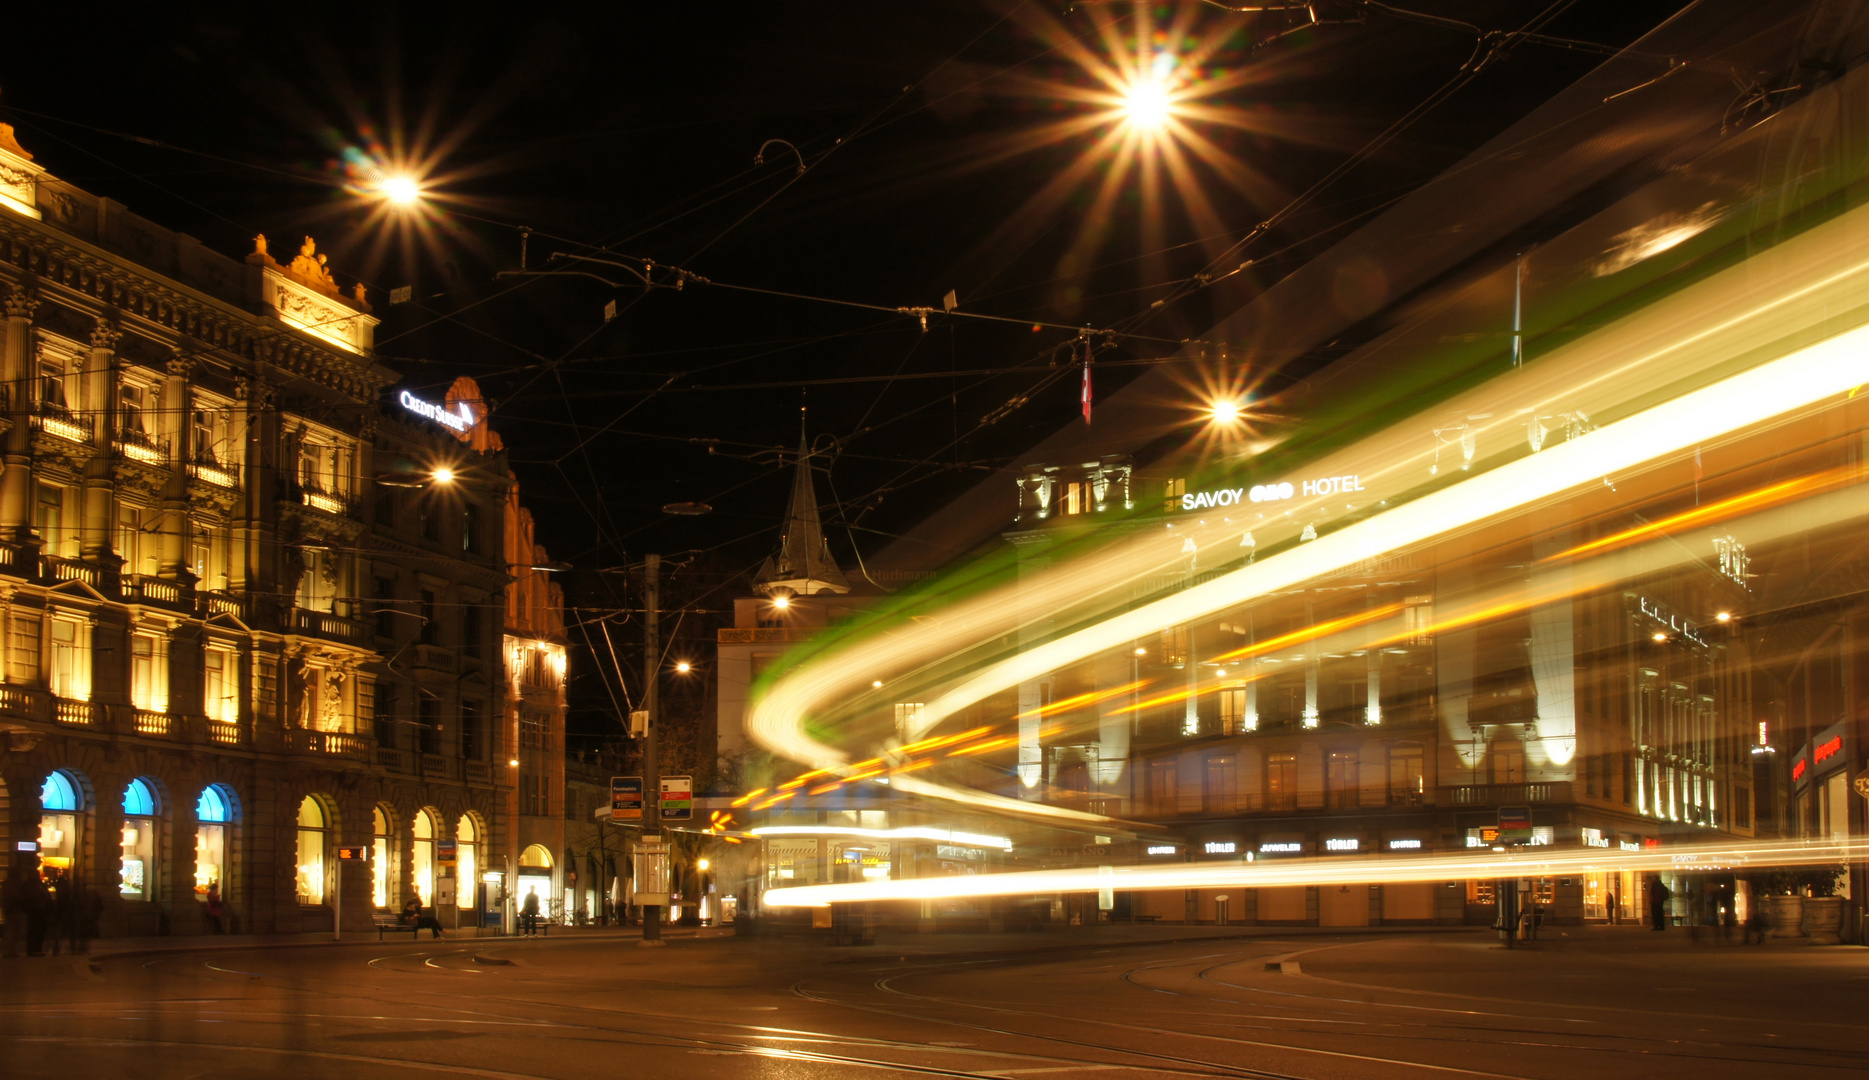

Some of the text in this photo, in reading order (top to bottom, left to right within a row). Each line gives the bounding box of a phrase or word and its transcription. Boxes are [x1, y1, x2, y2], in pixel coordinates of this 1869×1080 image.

[1183, 488, 1243, 510] SAVOY
[1303, 475, 1365, 496] HOTEL
[1205, 841, 1236, 853] TÜRLER
[1326, 839, 1359, 851] TÜRLER
